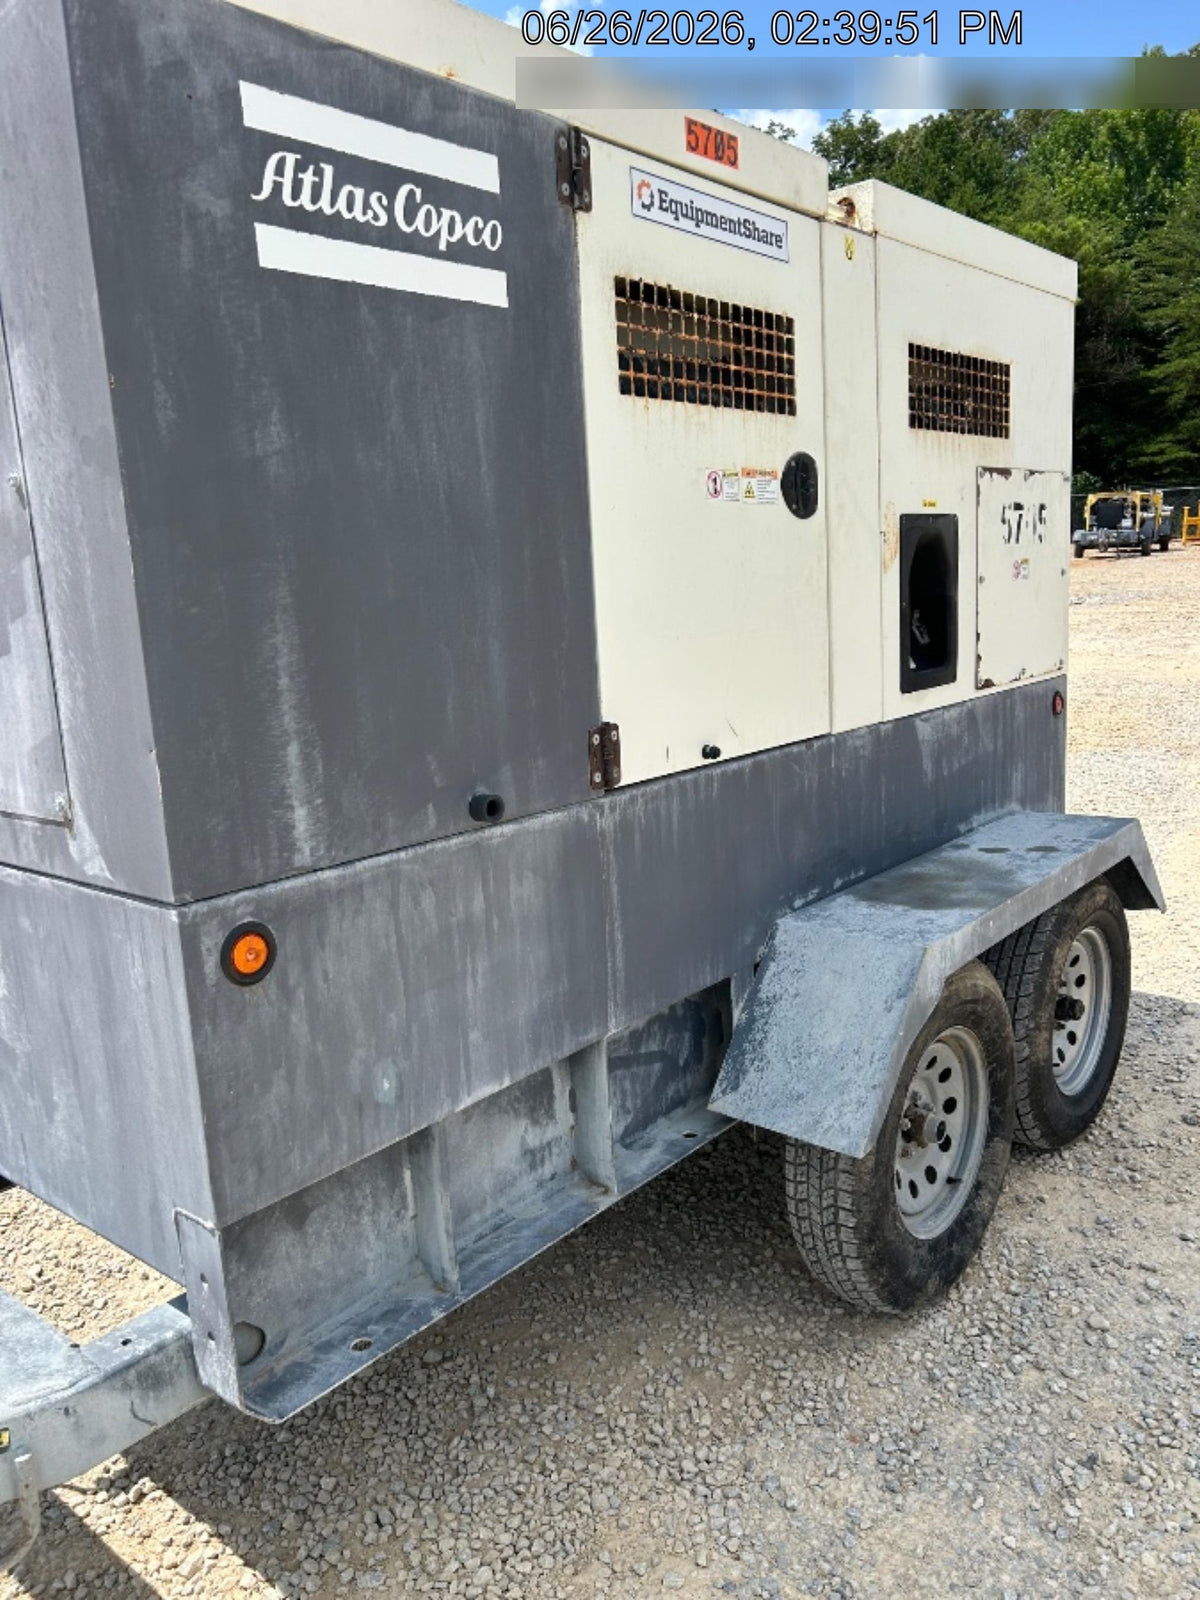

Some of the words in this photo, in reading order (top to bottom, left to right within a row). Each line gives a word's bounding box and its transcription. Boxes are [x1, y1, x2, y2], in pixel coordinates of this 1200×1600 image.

[687, 118, 738, 167] 5705
[251, 151, 389, 227] Atlas
[394, 183, 502, 252] Copco
[657, 188, 784, 250] EquipmentShare
